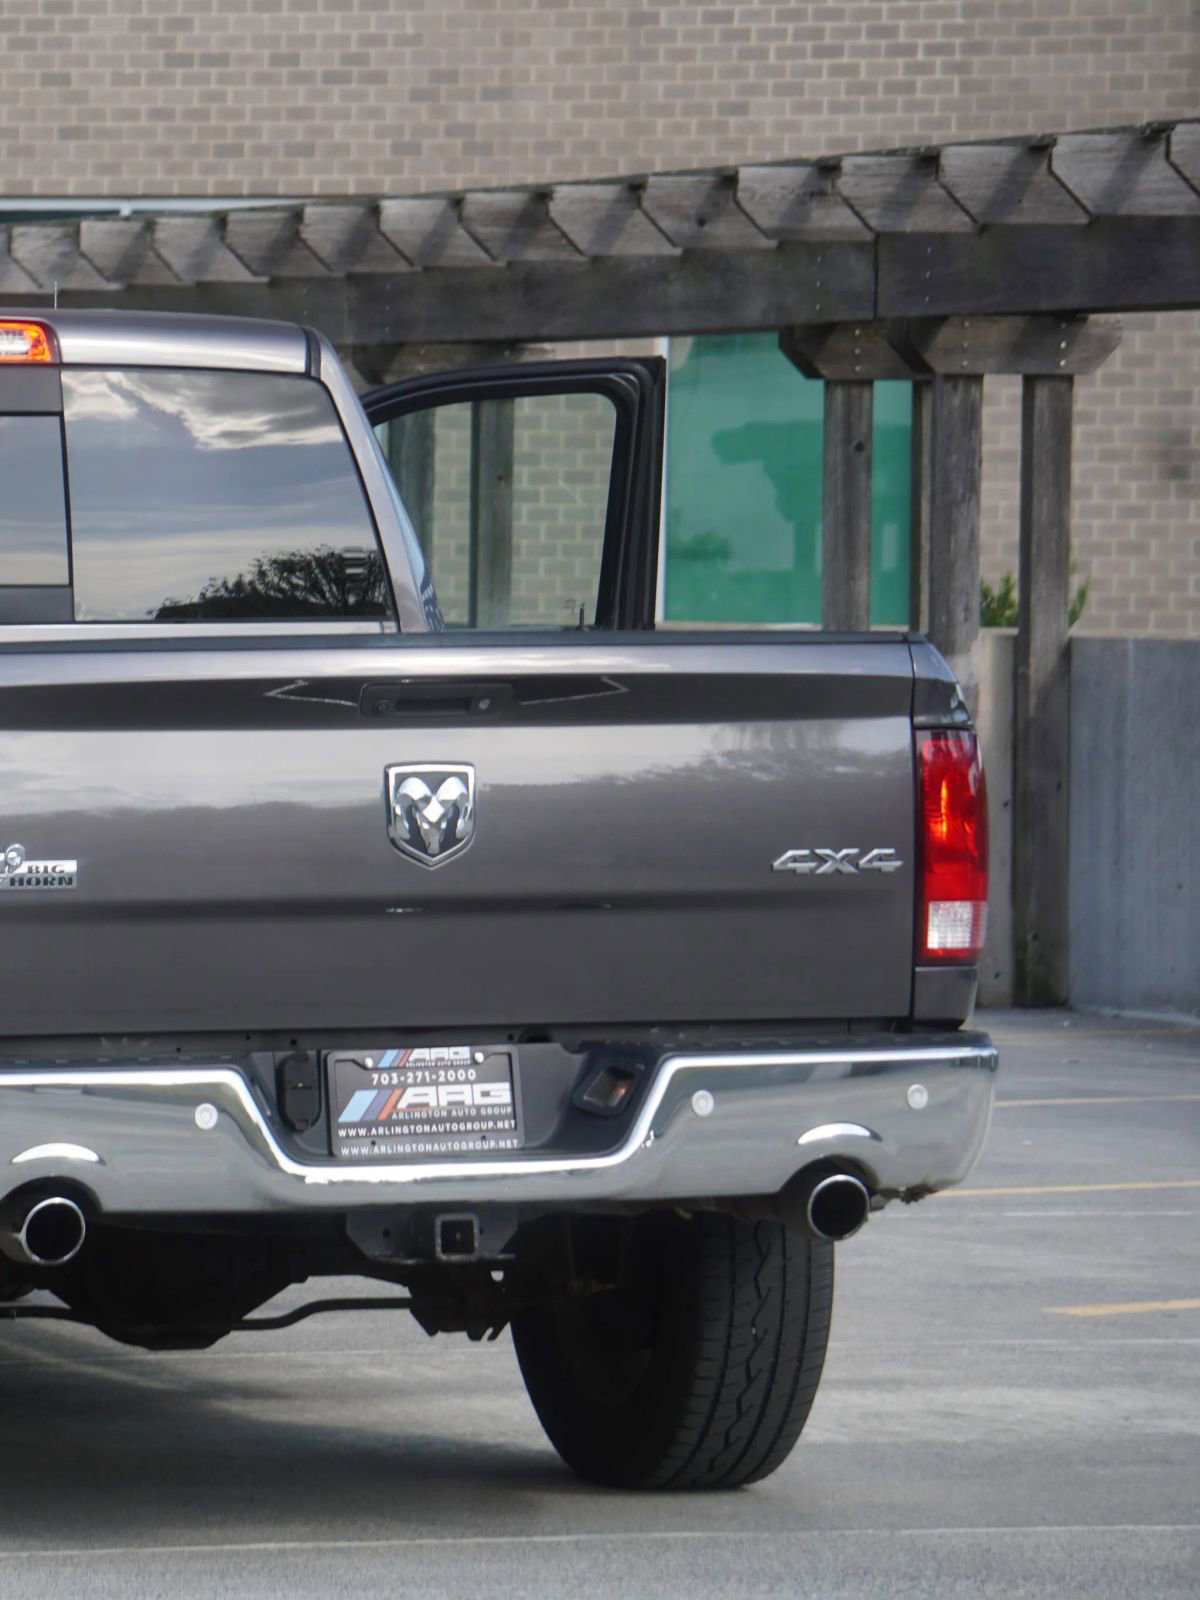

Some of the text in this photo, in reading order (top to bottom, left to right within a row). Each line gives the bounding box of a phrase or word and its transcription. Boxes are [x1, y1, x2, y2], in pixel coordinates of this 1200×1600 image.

[27, 865, 65, 874] BIG
[10, 876, 73, 887] HORN
[371, 1069, 477, 1086] 703-271-2000
[396, 1082, 512, 1109] AAG
[391, 1106, 512, 1121] ARLINGTON AUTO GROUP
[338, 1120, 516, 1138] WWW.ARLINGTONAUTOGROUP.NET
[340, 1138, 518, 1156] WWW.ARLINGTONAUTOGROUP.NET
